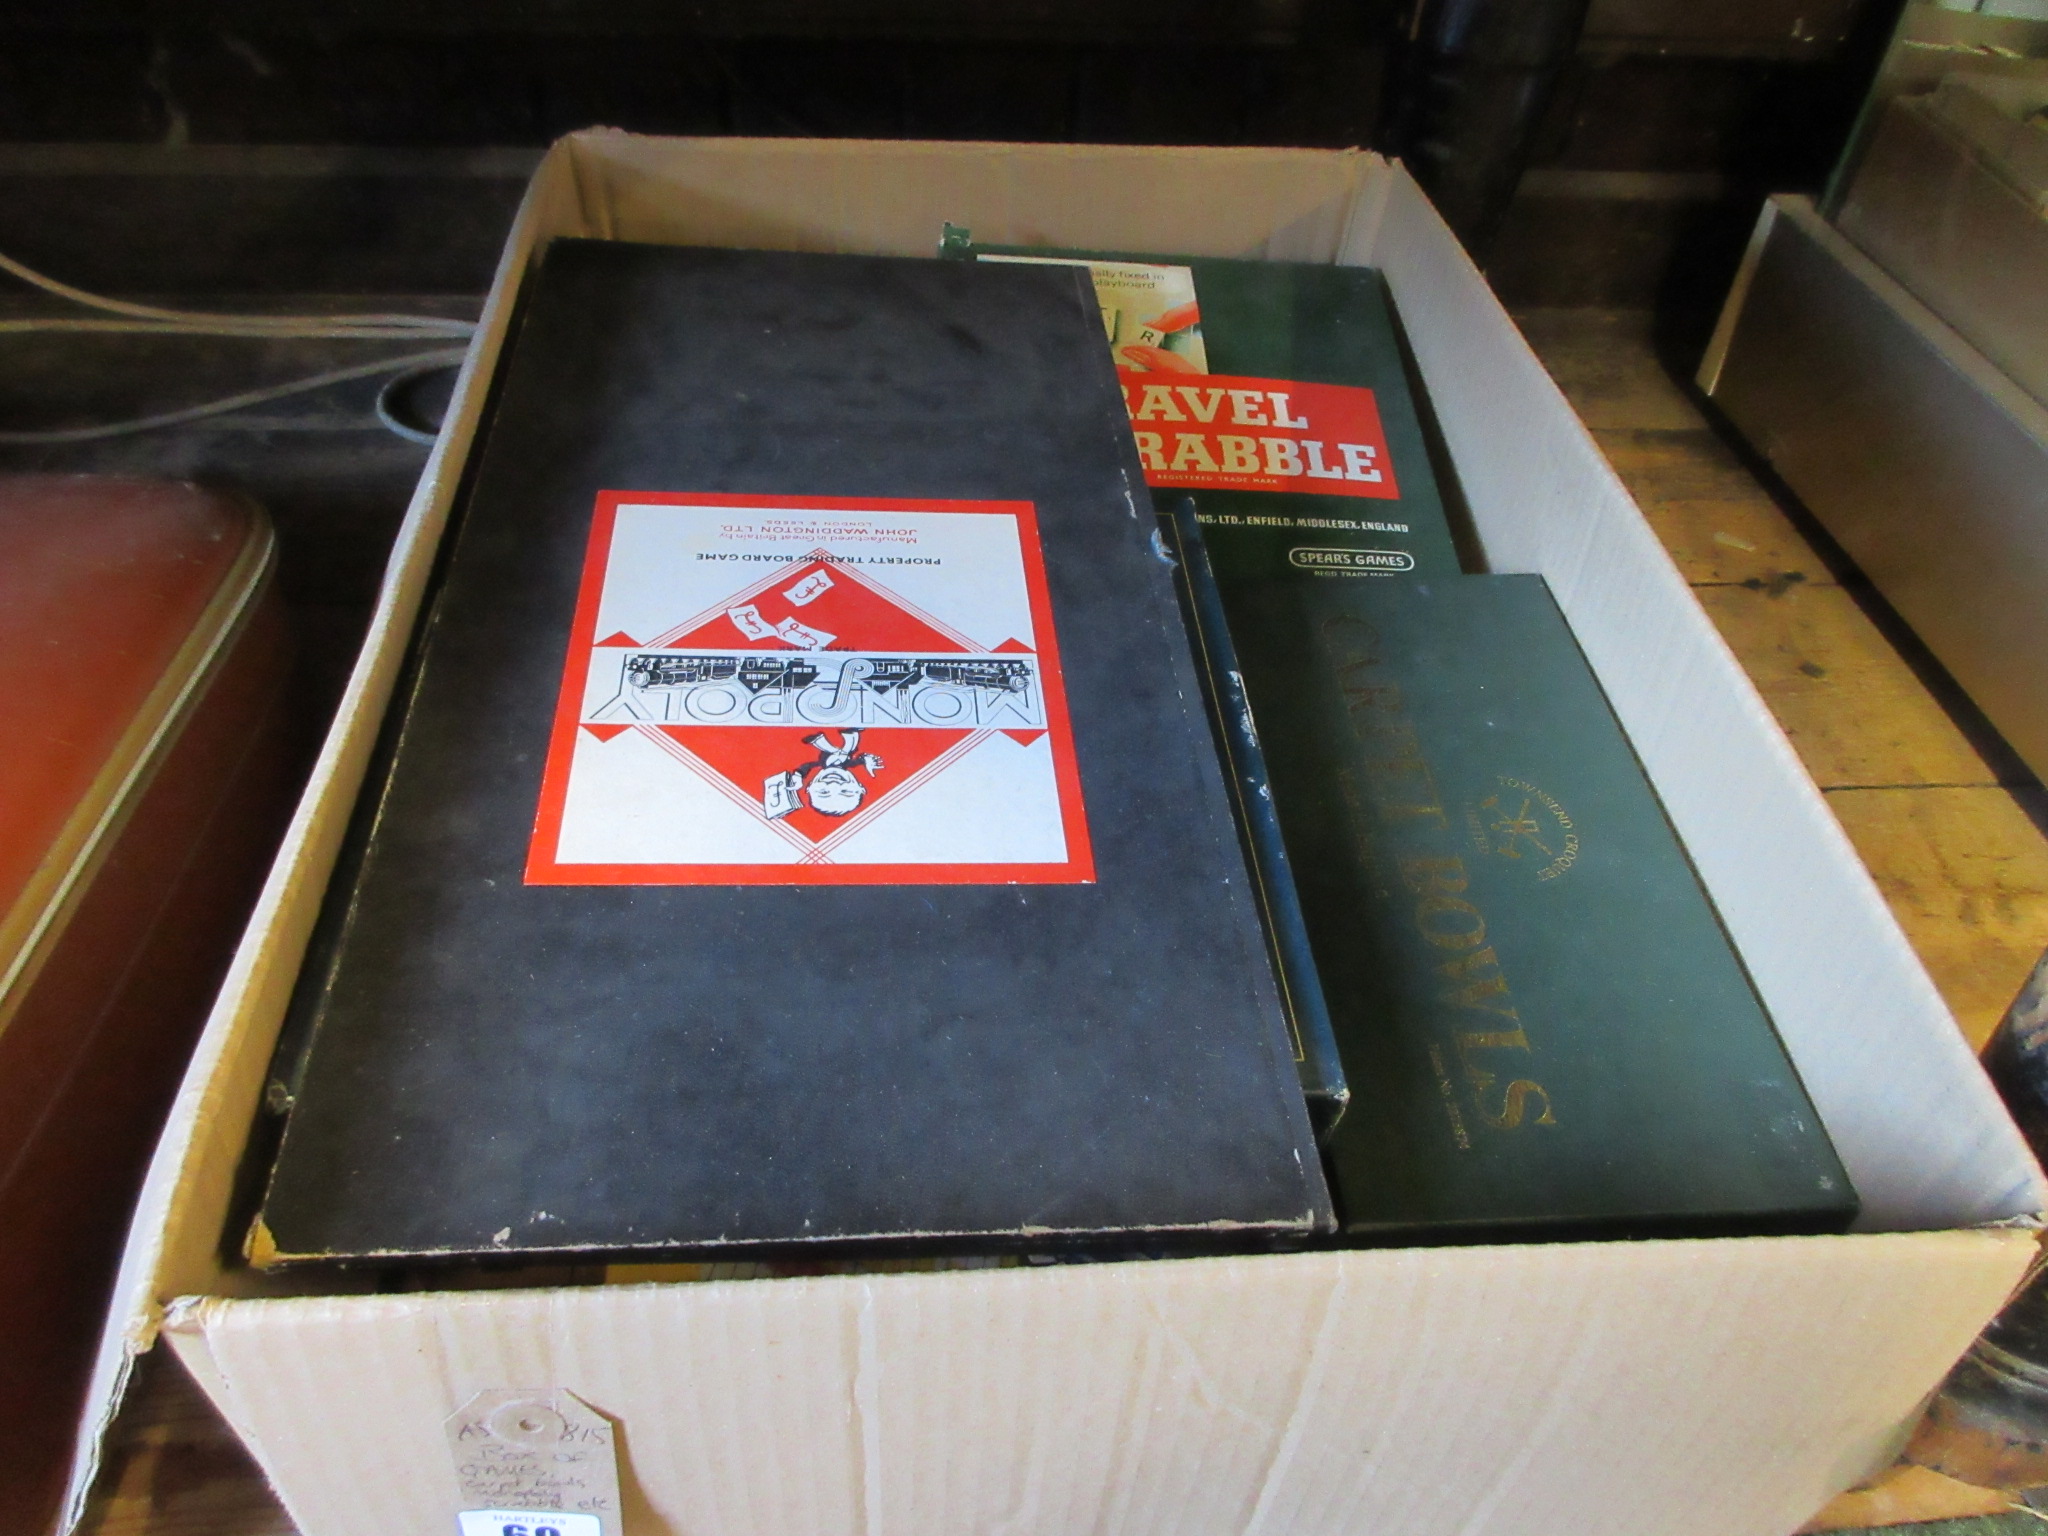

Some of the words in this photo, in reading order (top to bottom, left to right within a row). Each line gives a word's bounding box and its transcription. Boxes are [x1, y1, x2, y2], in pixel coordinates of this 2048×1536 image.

[1119, 271, 1150, 280] fixed
[1156, 474, 1214, 482] REGISTERED
[1218, 476, 1248, 484] TRADE
[761, 526, 869, 535] WADDINGTON
[874, 528, 918, 536] JOHN
[1361, 521, 1409, 533] ENGLAND
[718, 531, 733, 540] by
[735, 532, 777, 542] Britain
[779, 533, 815, 543] Great
[817, 534, 827, 543] in
[830, 533, 918, 545] Manufactured
[695, 552, 739, 562] GAME
[741, 553, 794, 563] BOARD
[798, 554, 864, 564] TRADING
[869, 556, 941, 566] PROPERTY
[1299, 552, 1351, 564] SPEAR'S
[1355, 554, 1405, 567] GAMES
[588, 653, 1043, 726] MONOPOLY
[1496, 774, 1574, 831] TOWNSEND
[1537, 832, 1581, 884] CROQUET
[1402, 855, 1558, 1130] BOWLS
